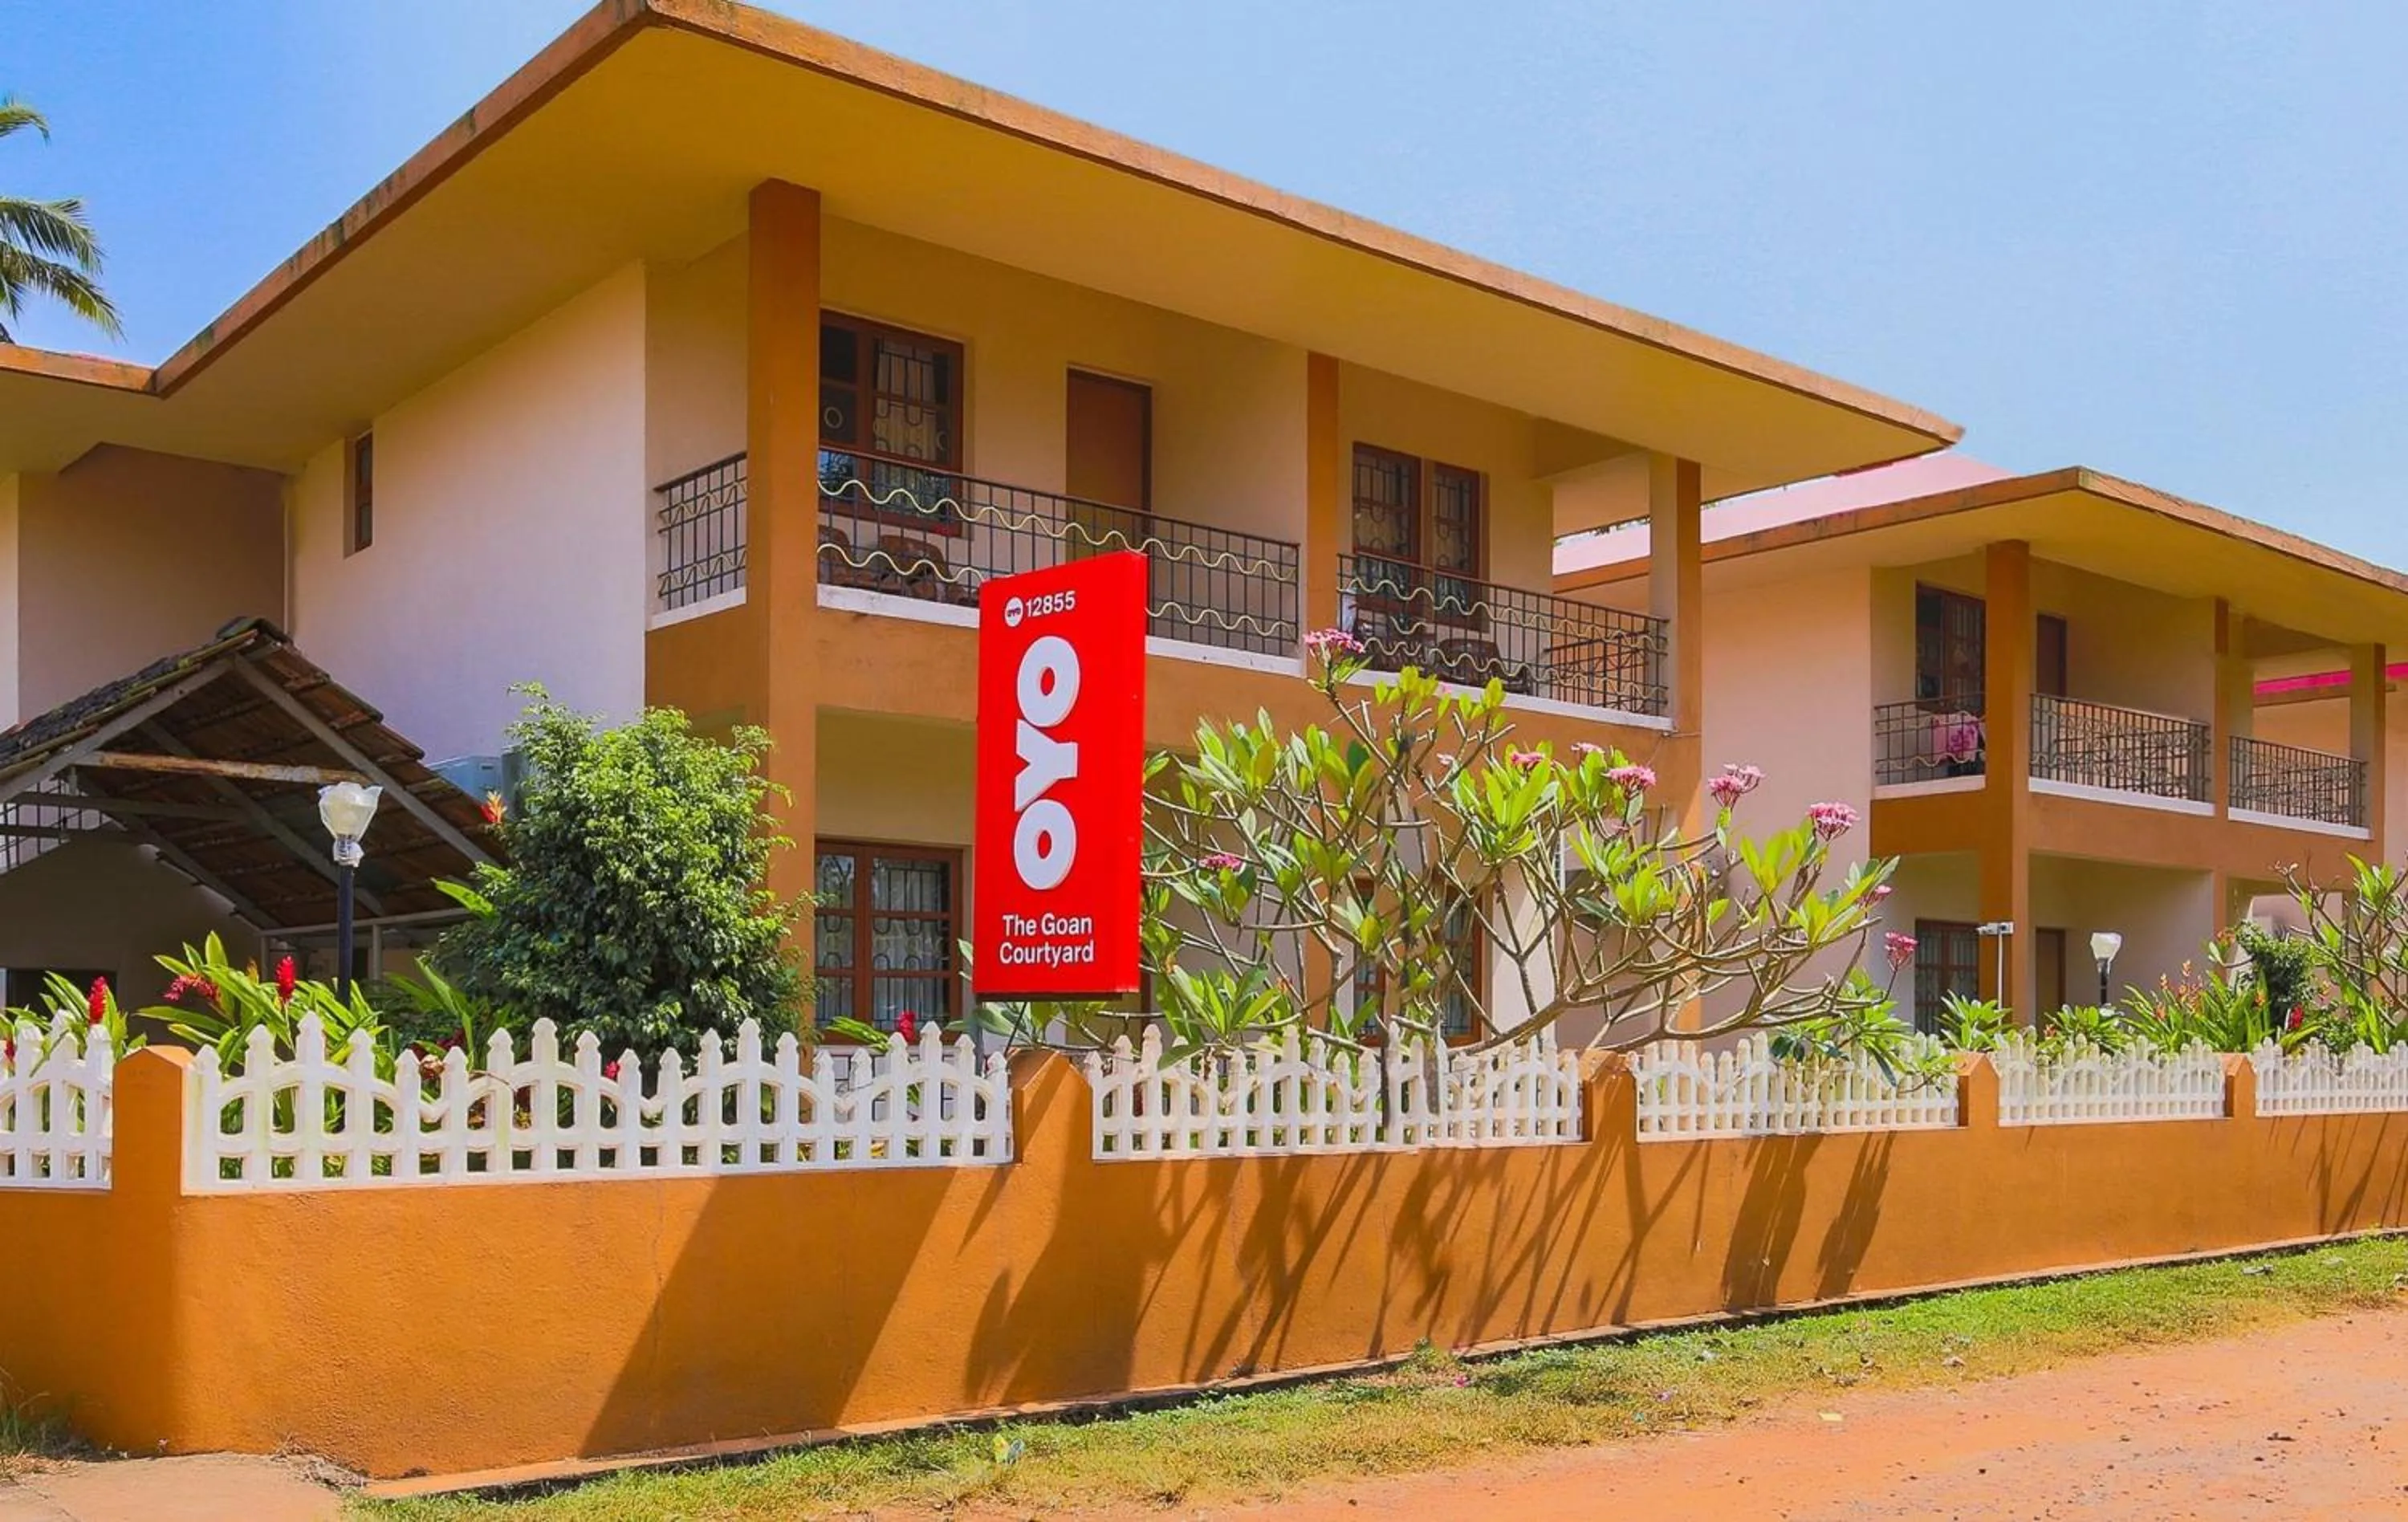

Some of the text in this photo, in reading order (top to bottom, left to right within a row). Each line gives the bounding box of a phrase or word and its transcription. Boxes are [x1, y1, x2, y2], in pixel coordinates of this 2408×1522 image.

[1026, 590, 1076, 617] 12855
[1014, 635, 1080, 890] OYO
[1002, 912, 1092, 937] The Goan
[999, 940, 1094, 968] Courtyard
